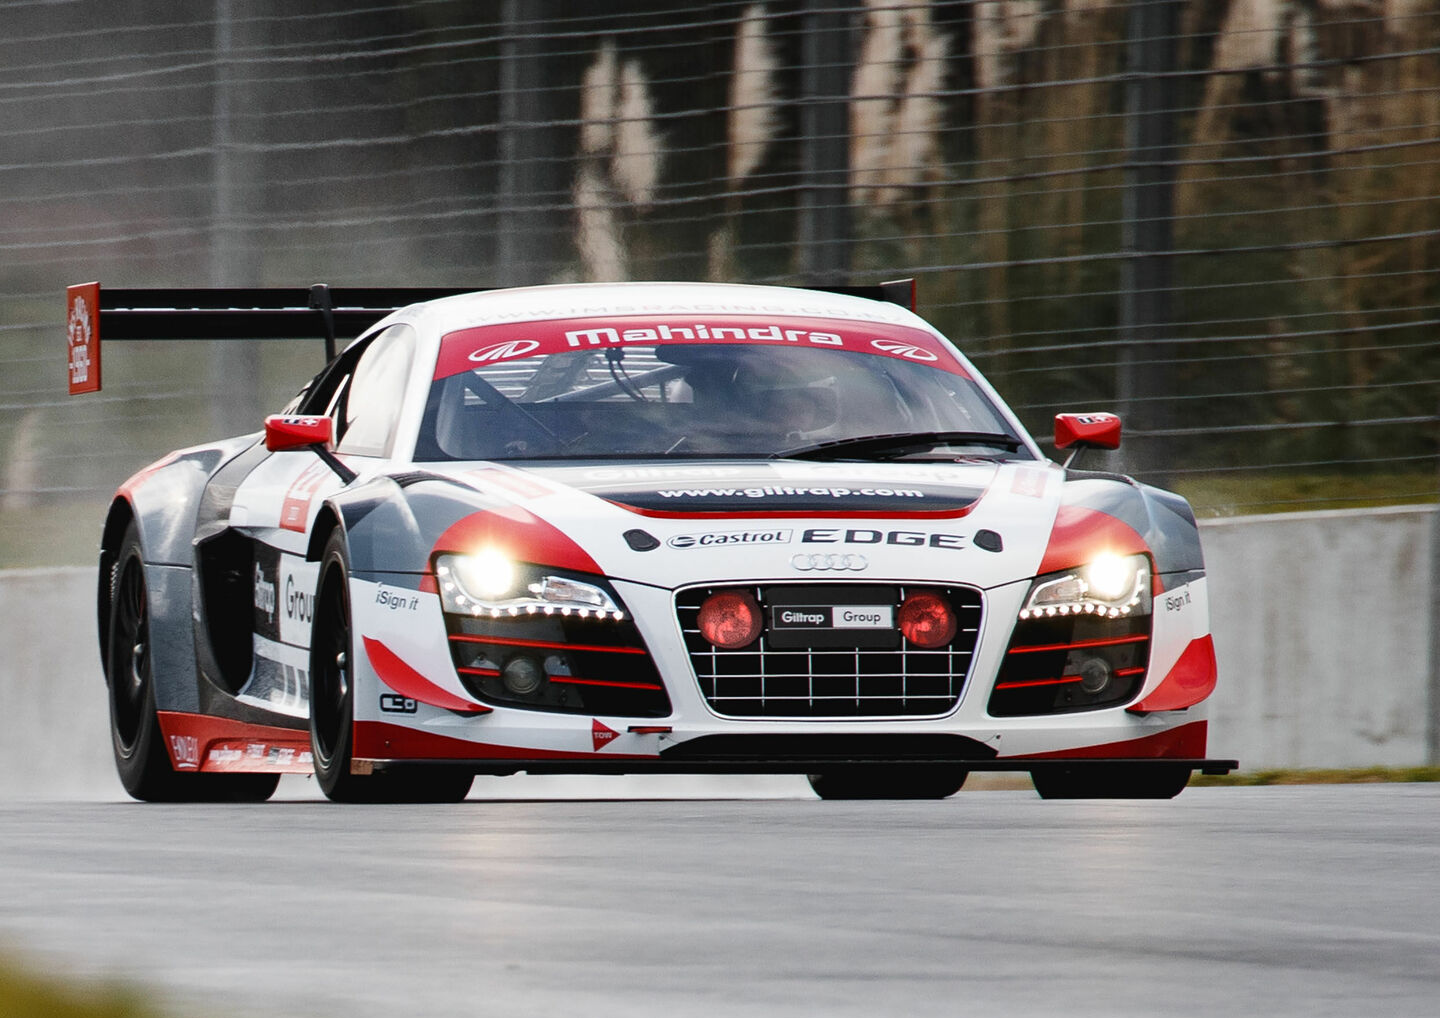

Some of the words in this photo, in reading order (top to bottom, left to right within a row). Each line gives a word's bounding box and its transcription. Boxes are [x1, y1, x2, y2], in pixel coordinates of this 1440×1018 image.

[658, 485, 924, 498] www.giltrap.com
[698, 530, 784, 546] Castrol
[800, 528, 966, 550] EDGE
[285, 574, 314, 623] Grou
[375, 590, 407, 610] iSign
[408, 596, 420, 611] it
[780, 610, 825, 625] Giltrap
[842, 610, 882, 625] Group
[593, 731, 613, 739] TOW
